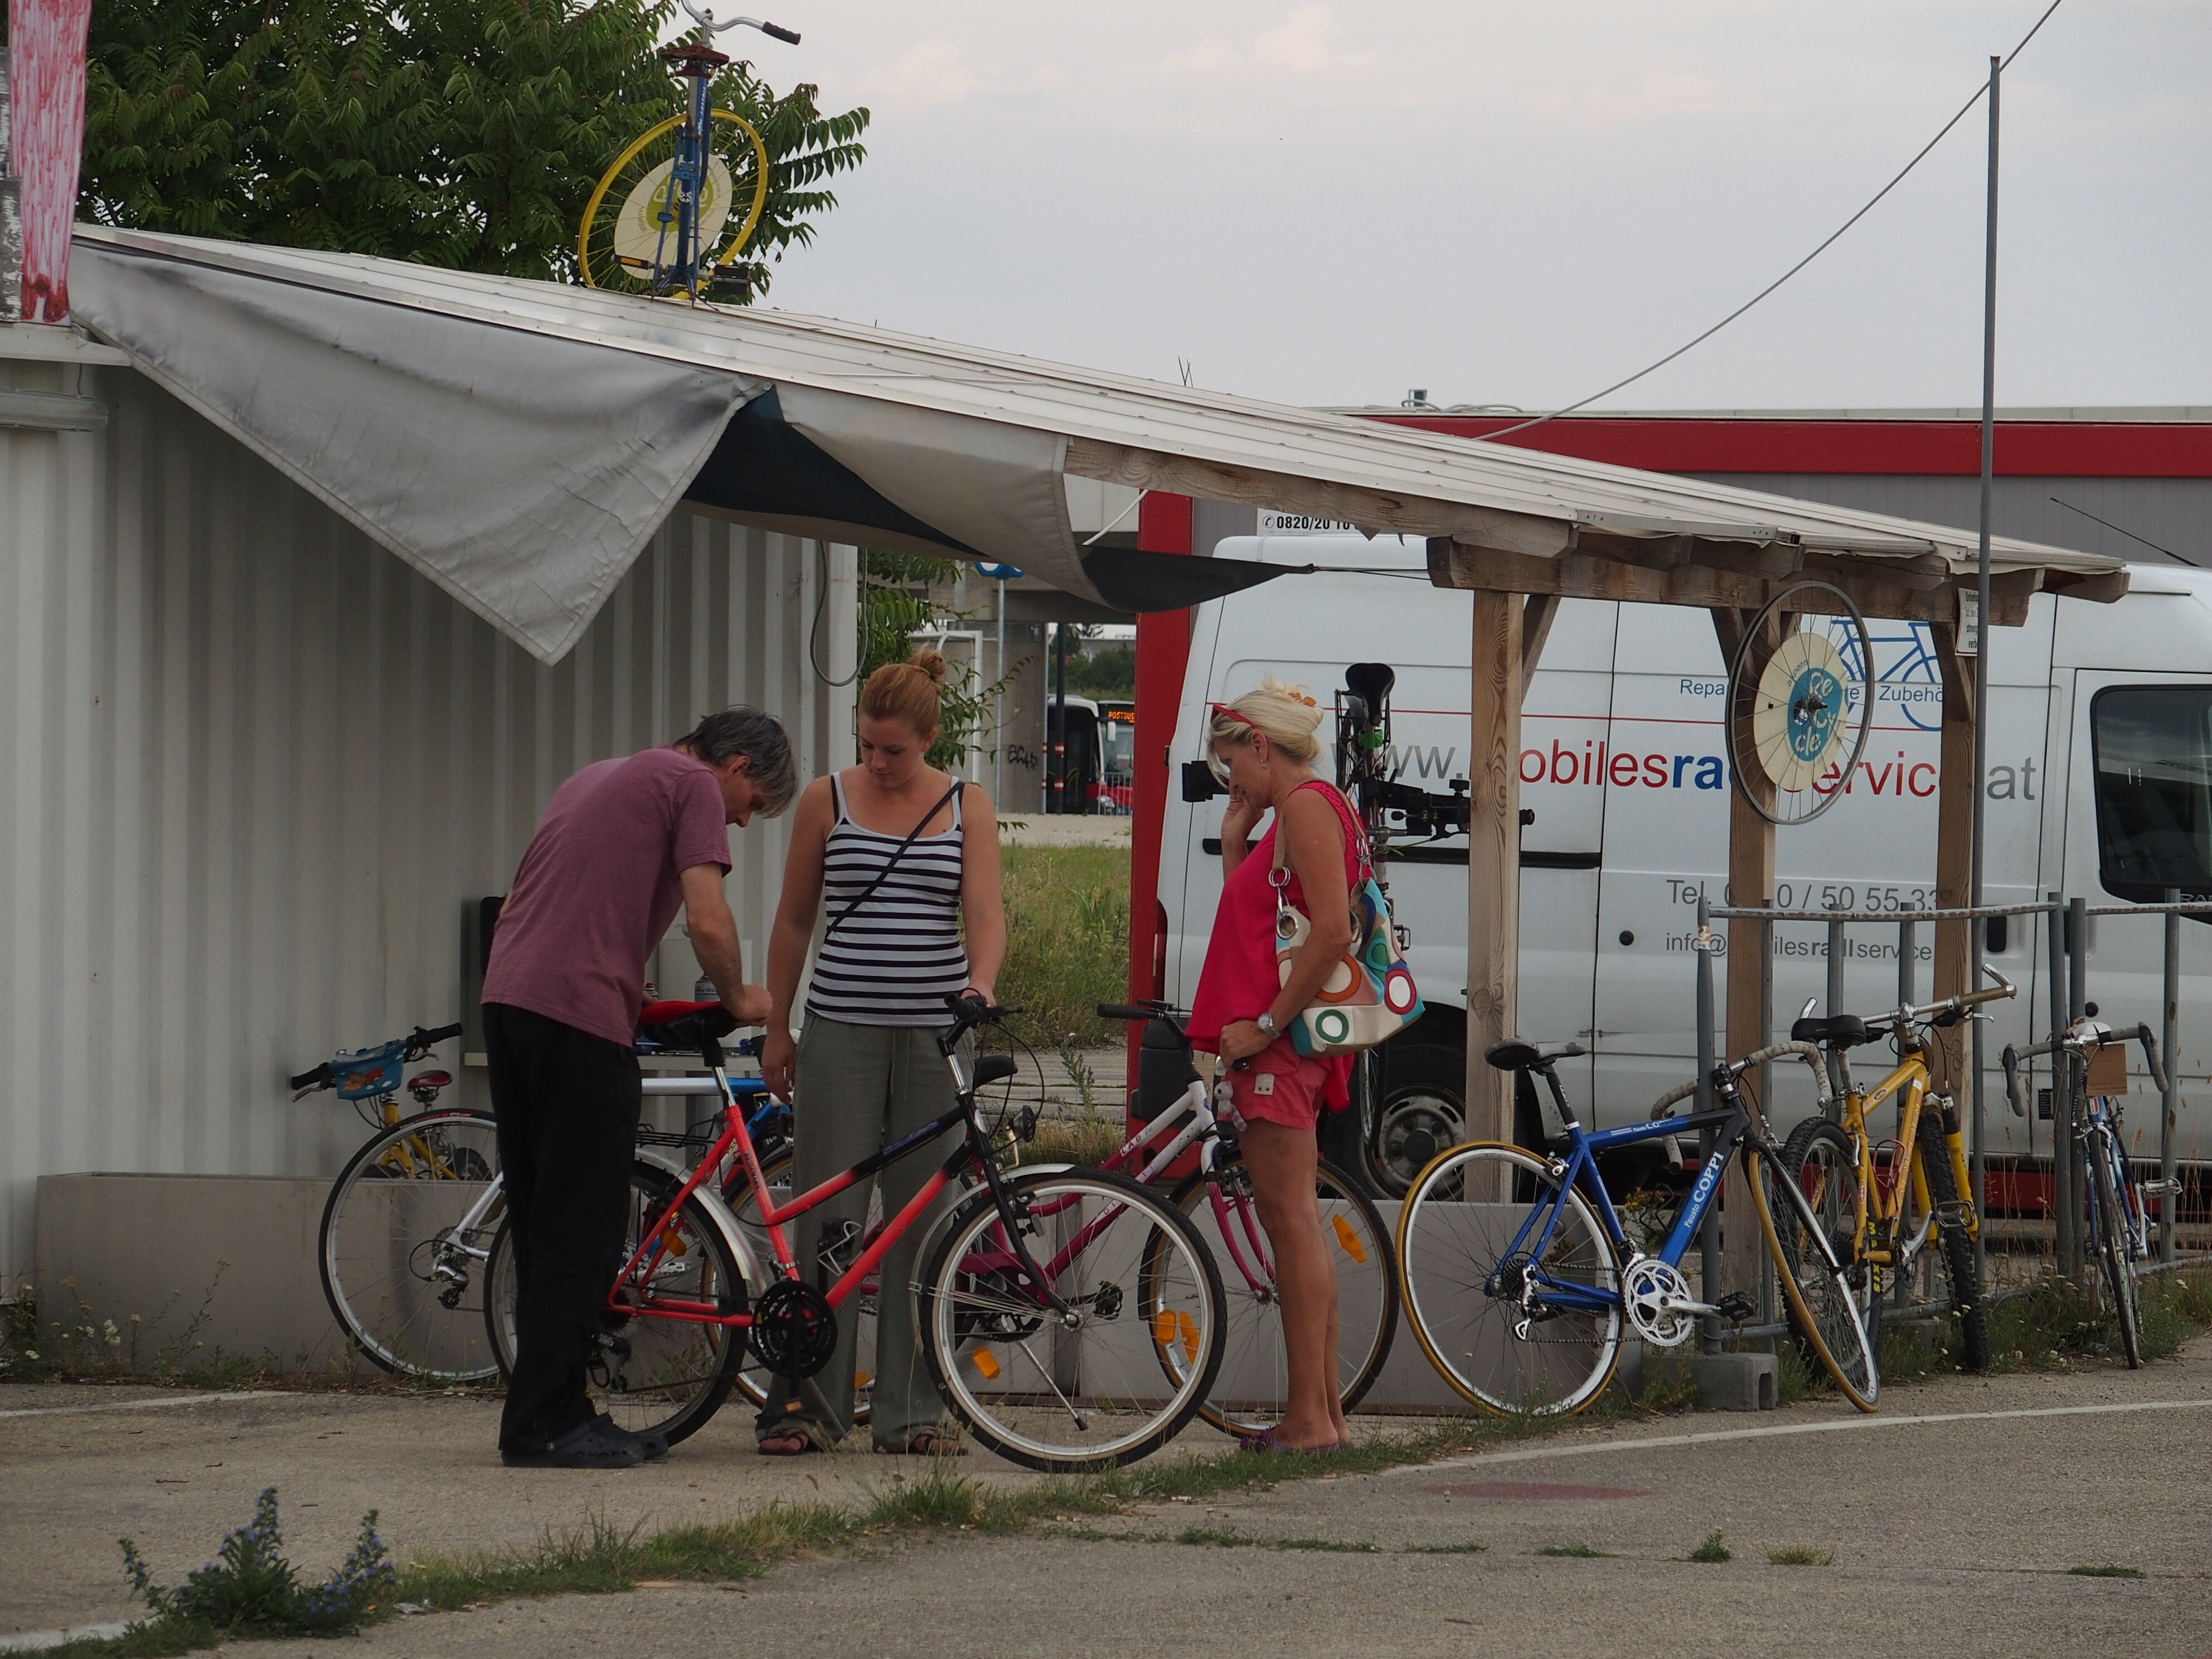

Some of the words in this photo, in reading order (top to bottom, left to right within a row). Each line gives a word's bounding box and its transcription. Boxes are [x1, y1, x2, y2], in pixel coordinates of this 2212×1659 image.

[1277, 516, 1330, 530] 0820/20
[1879, 685, 1943, 703] Zubehö
[1821, 885, 1855, 911] 50
[1865, 887, 1900, 912] 55
[1684, 1203, 1700, 1229] Fausto
[1694, 1151, 1725, 1203] COPPI
[1867, 1221, 1881, 1294] MAXIS
